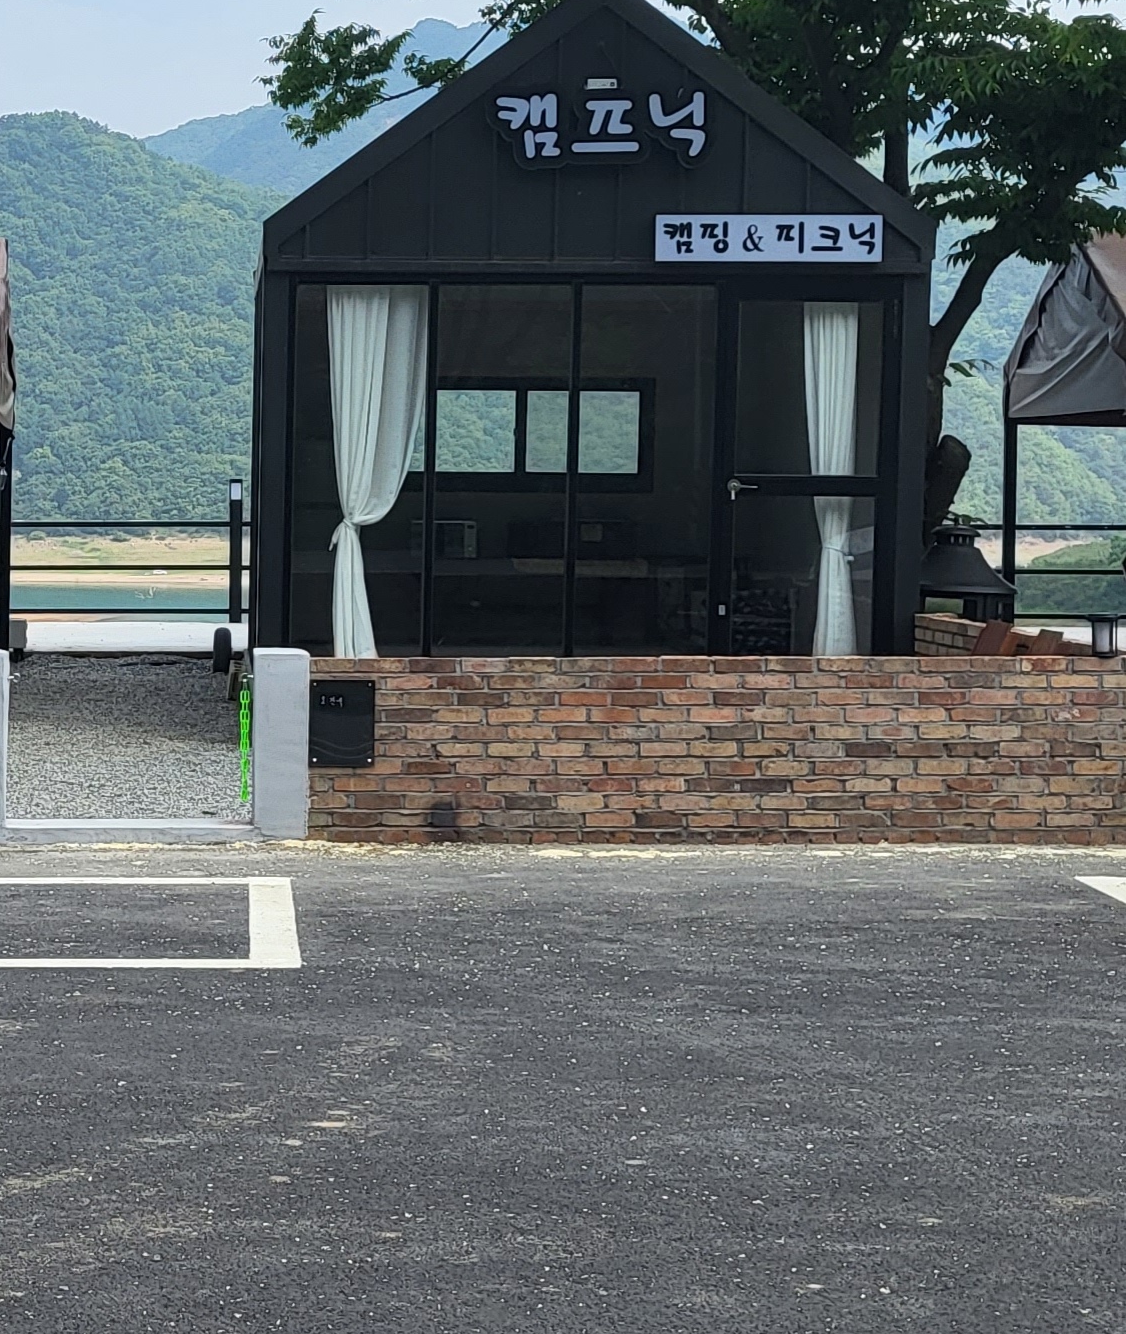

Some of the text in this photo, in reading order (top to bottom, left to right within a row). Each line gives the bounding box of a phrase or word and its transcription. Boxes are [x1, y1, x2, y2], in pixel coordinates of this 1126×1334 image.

[496, 91, 706, 158] 캠프닉
[663, 221, 876, 255] 캠핑 & 피크닉
